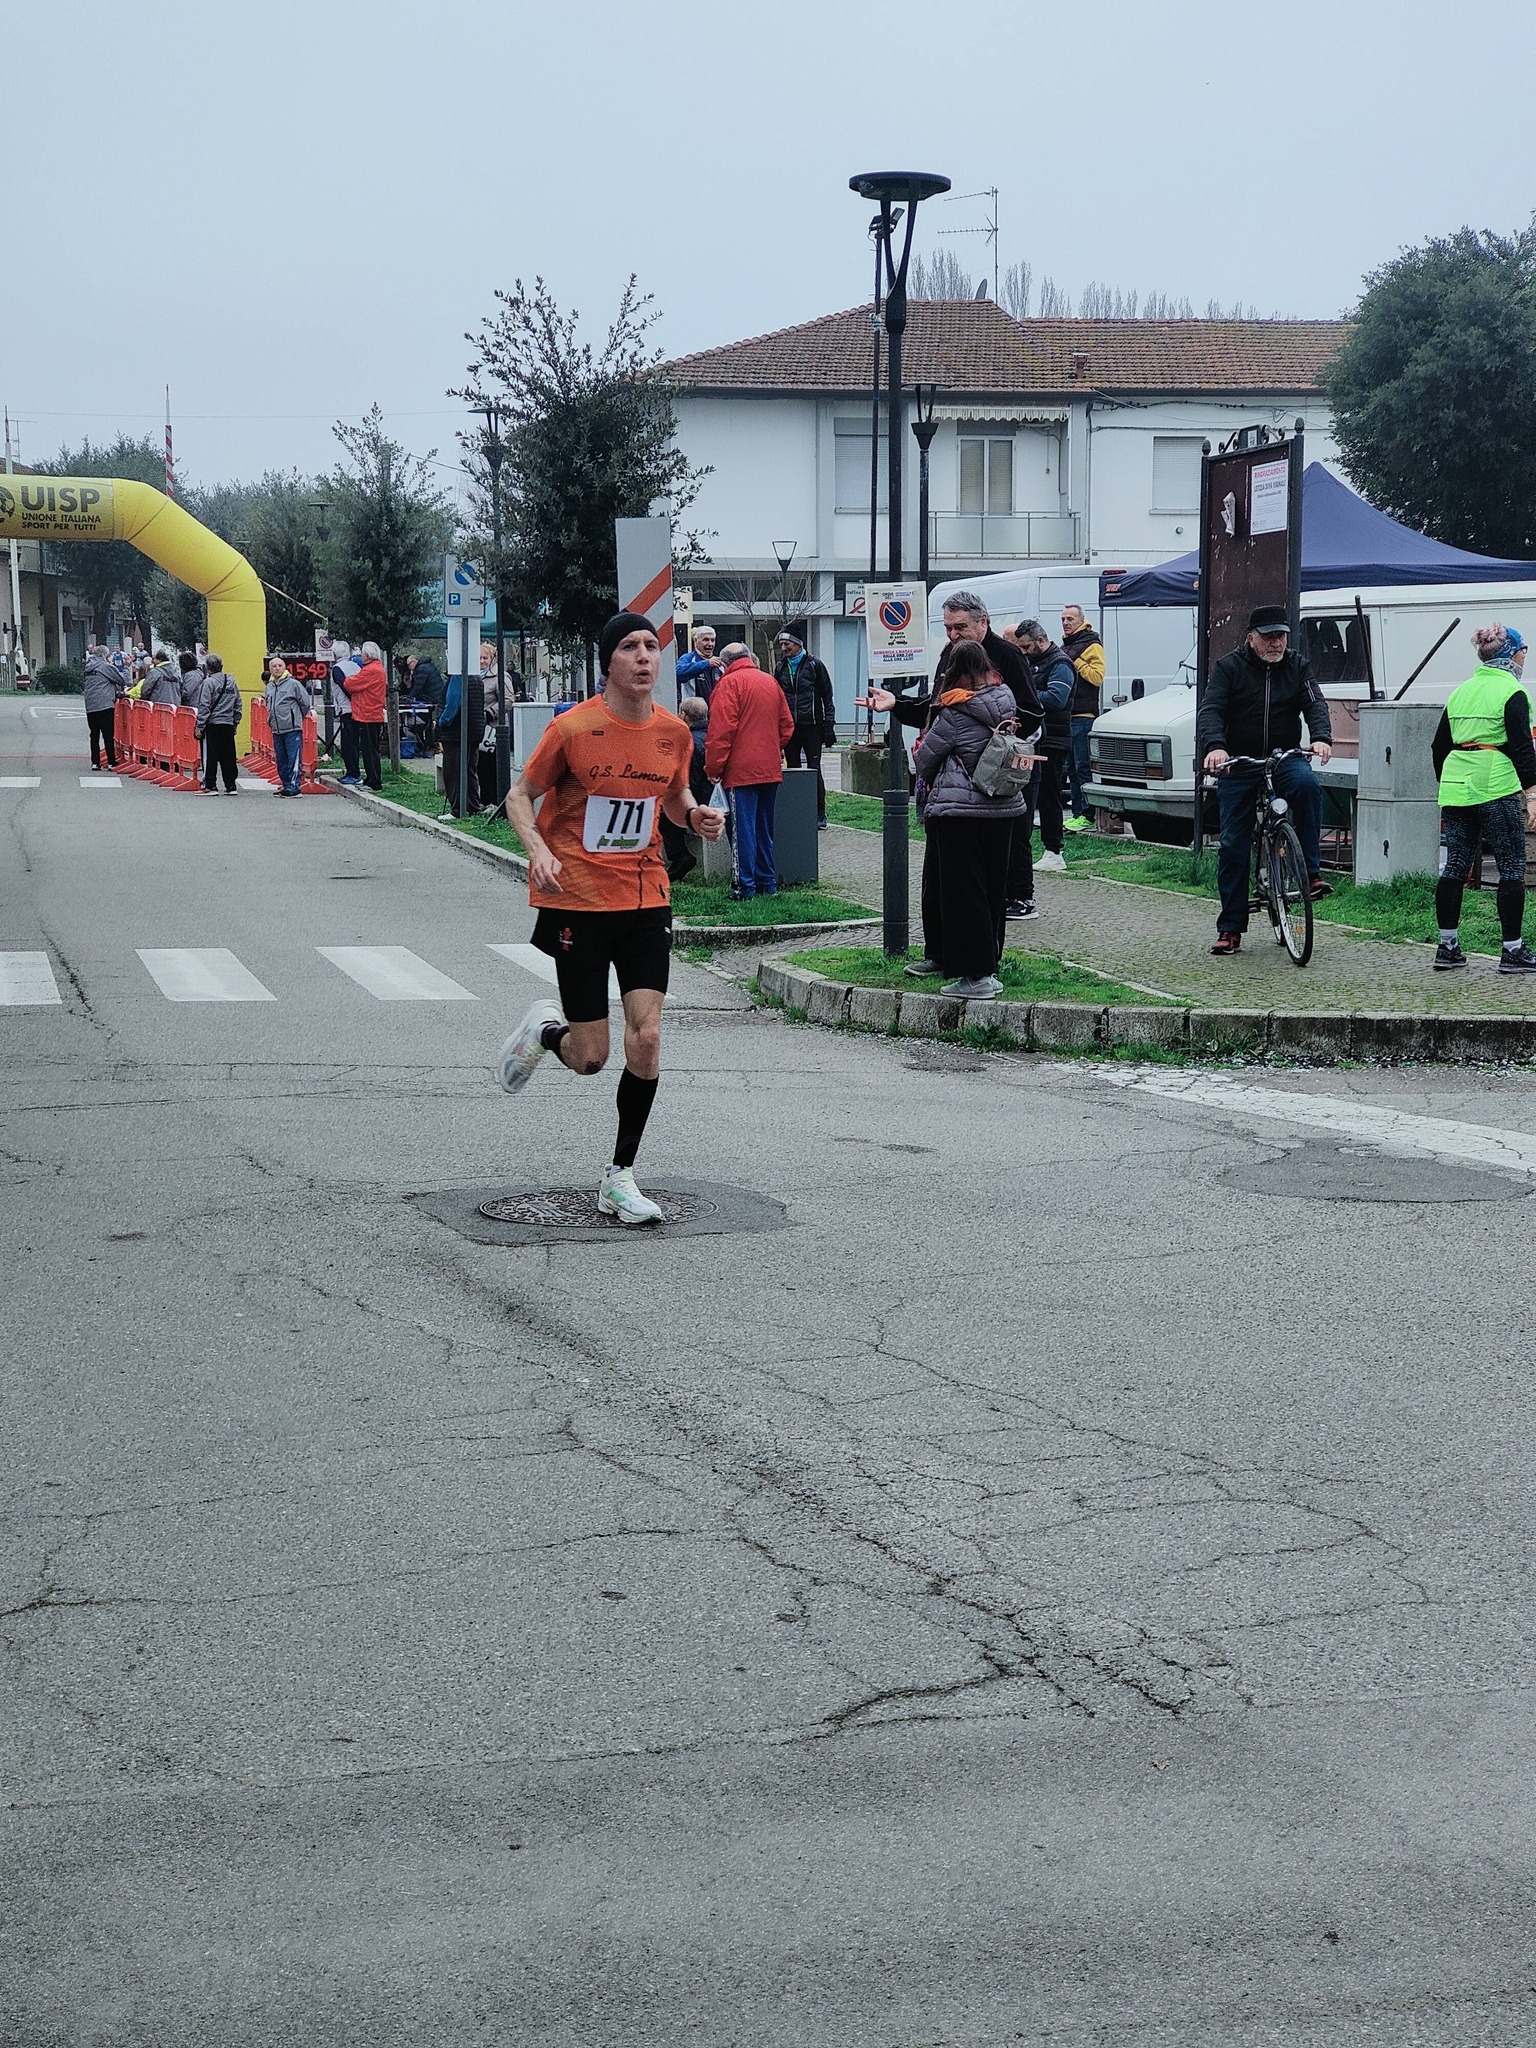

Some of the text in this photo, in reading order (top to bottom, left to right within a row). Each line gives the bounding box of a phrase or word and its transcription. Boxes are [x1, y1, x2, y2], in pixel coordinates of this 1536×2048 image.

[20, 485, 100, 513] UISP
[21, 512, 102, 523] UNIONE ITALIANA
[21, 521, 50, 529] SPORT
[54, 522, 70, 530] PER
[450, 594, 459, 604] P
[619, 764, 670, 784] Lamone
[606, 800, 646, 835] 771
